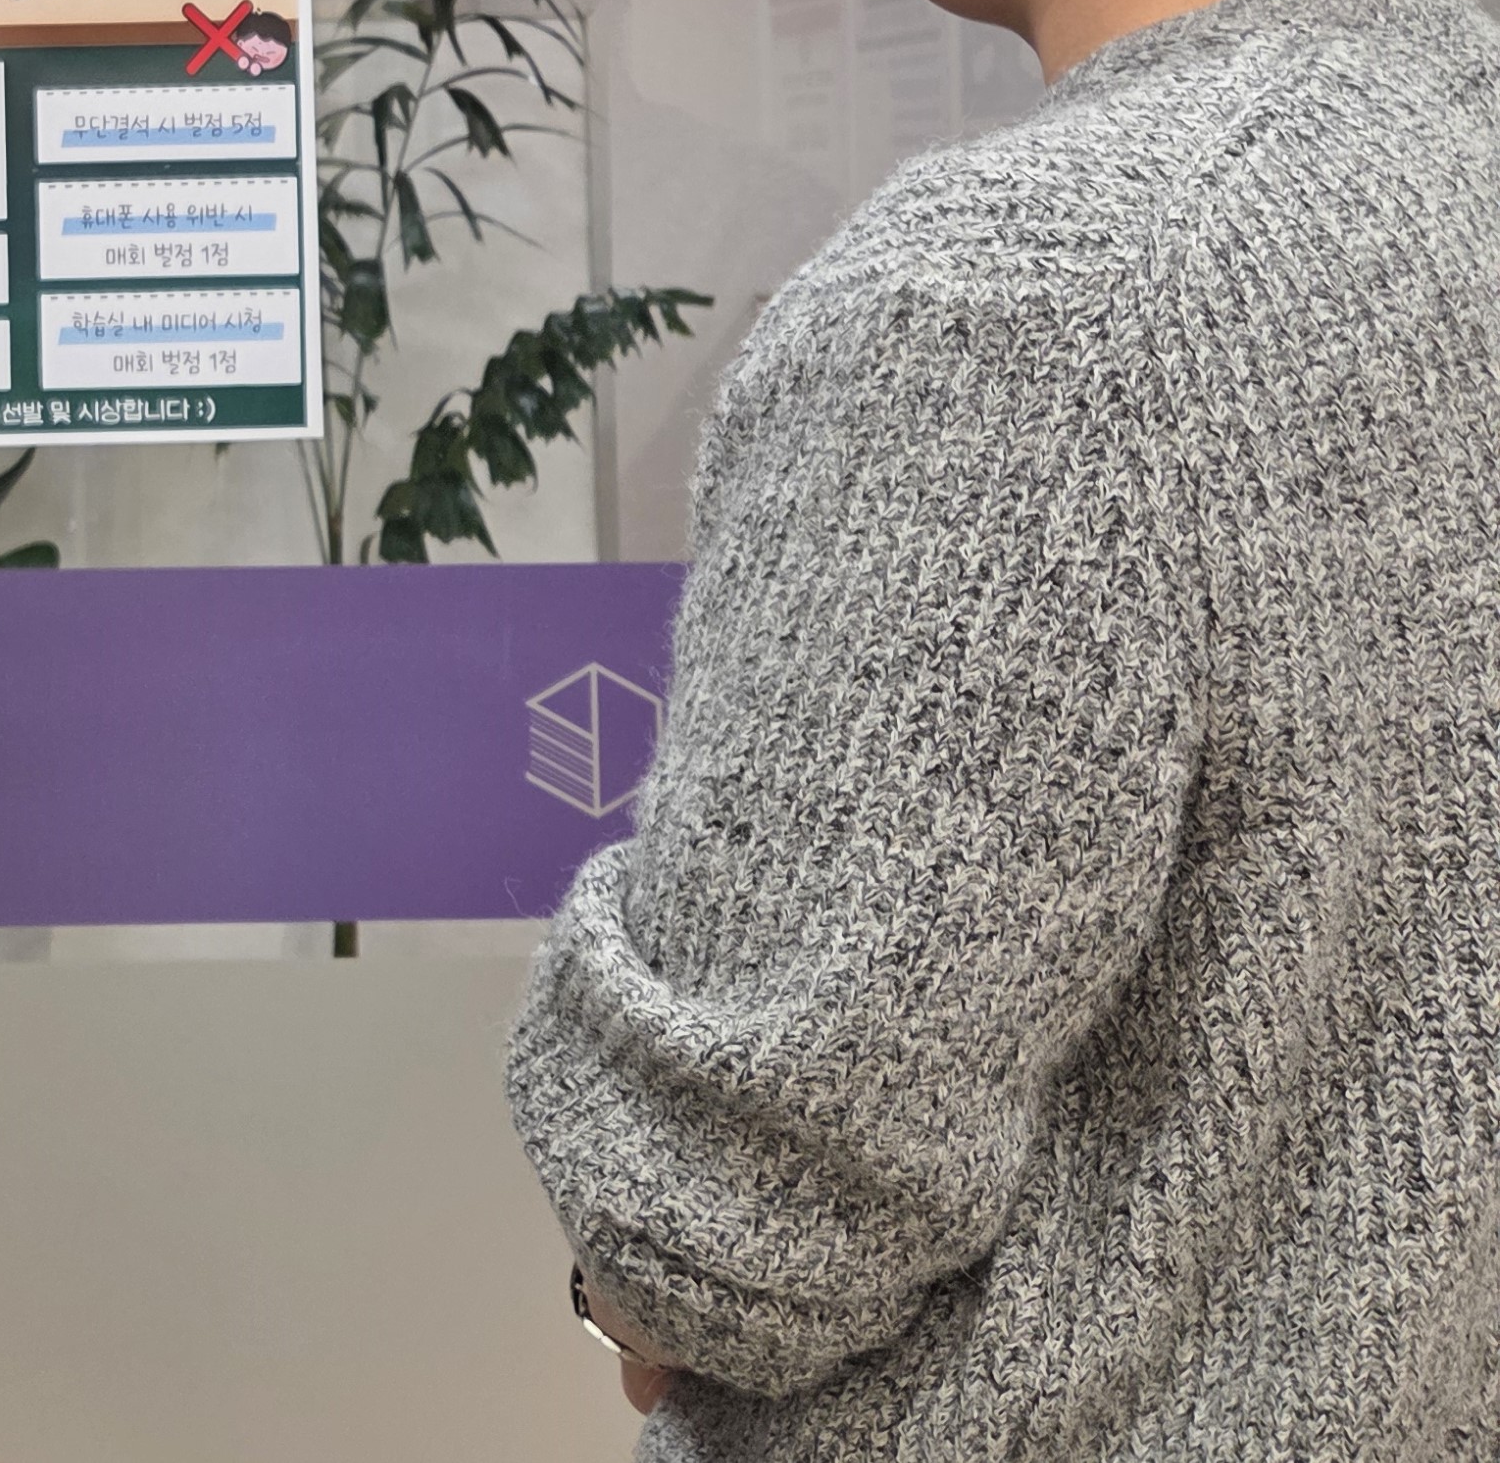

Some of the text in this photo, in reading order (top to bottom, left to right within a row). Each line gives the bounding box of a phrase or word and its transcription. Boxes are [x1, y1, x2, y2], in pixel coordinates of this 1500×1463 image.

[73, 111, 262, 140] 무단결석 시 벌점 5점
[81, 202, 253, 229] 휴대폰 사용 위반 시
[105, 242, 229, 268] 매회 벌점 1점
[72, 307, 262, 337] 학습실 내 미디어 시청
[113, 349, 237, 375] 매회 벌점 1점
[2, 400, 44, 426] 선발
[49, 399, 71, 426] 및
[78, 397, 190, 426] 시상합니다
[197, 397, 216, 424] :)
